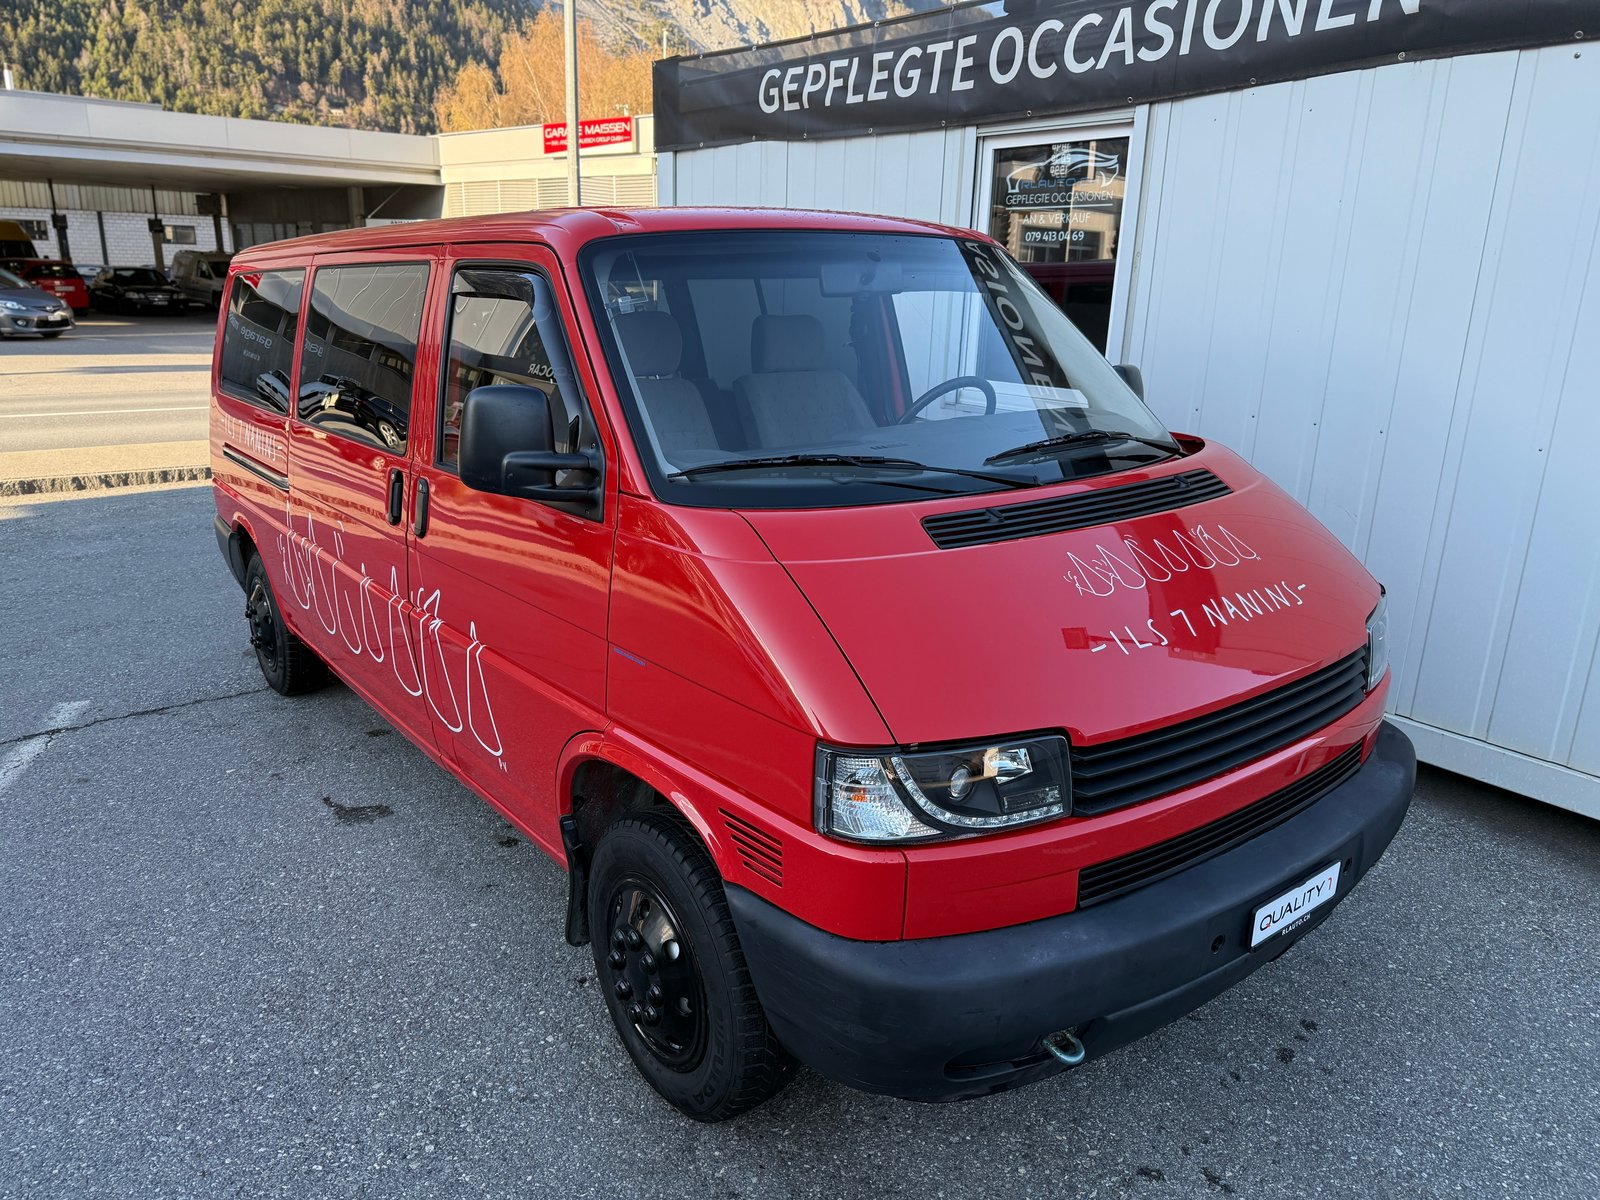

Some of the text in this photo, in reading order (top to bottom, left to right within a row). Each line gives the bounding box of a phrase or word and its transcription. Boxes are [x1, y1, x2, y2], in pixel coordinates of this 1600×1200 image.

[758, 35, 977, 114] GEPFLEGTE
[545, 122, 630, 138] GARAE MAISSEN
[1006, 190, 1113, 205] GEPFLEGTE OCCASIONEN
[1023, 213, 1090, 225] AN & VERKAUF
[1025, 231, 1084, 241] 079 413 04 69
[1260, 880, 1325, 931] QUALITY
[1281, 913, 1311, 936] RLAUTO.CH
